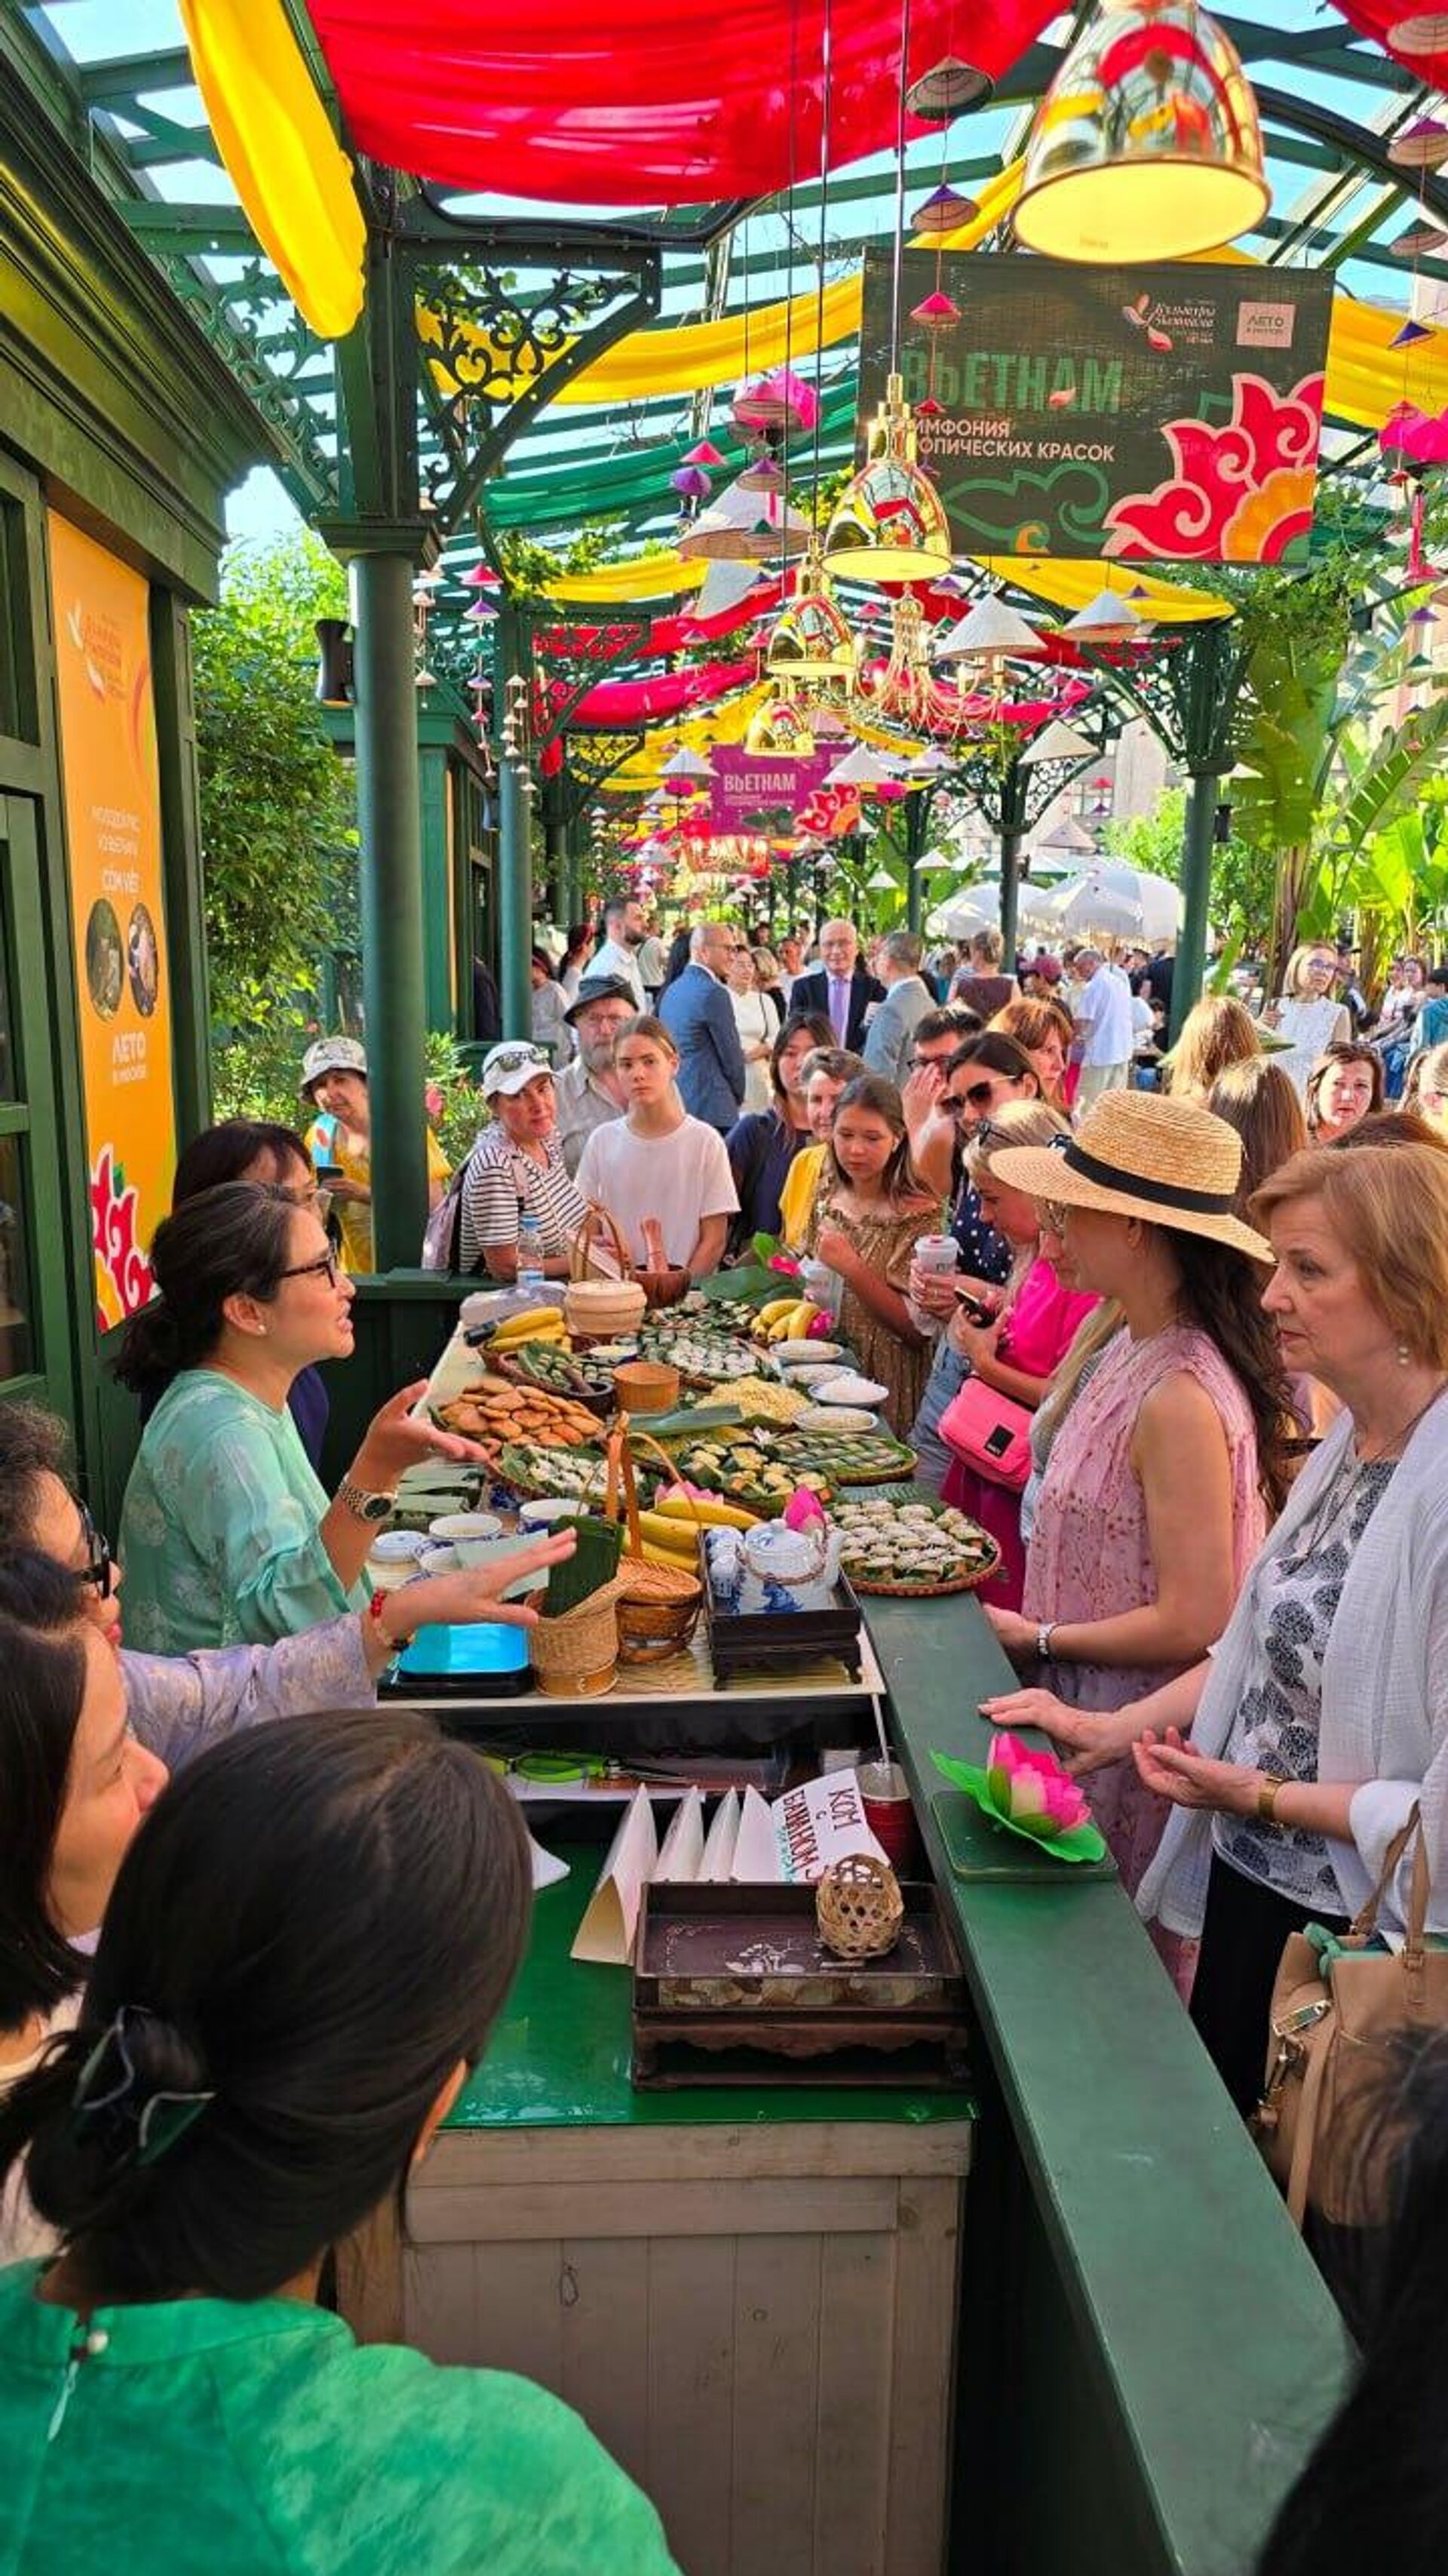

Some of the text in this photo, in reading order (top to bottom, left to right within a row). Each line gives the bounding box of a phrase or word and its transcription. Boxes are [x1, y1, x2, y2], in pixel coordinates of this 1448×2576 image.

[915, 417, 1011, 438] ИМФОНИЯ
[919, 439, 1115, 462] ОПИЧЕСКИХ КРАСОК
[113, 1031, 146, 1064] ЛЕТО
[828, 1788, 861, 1831] КОМ
